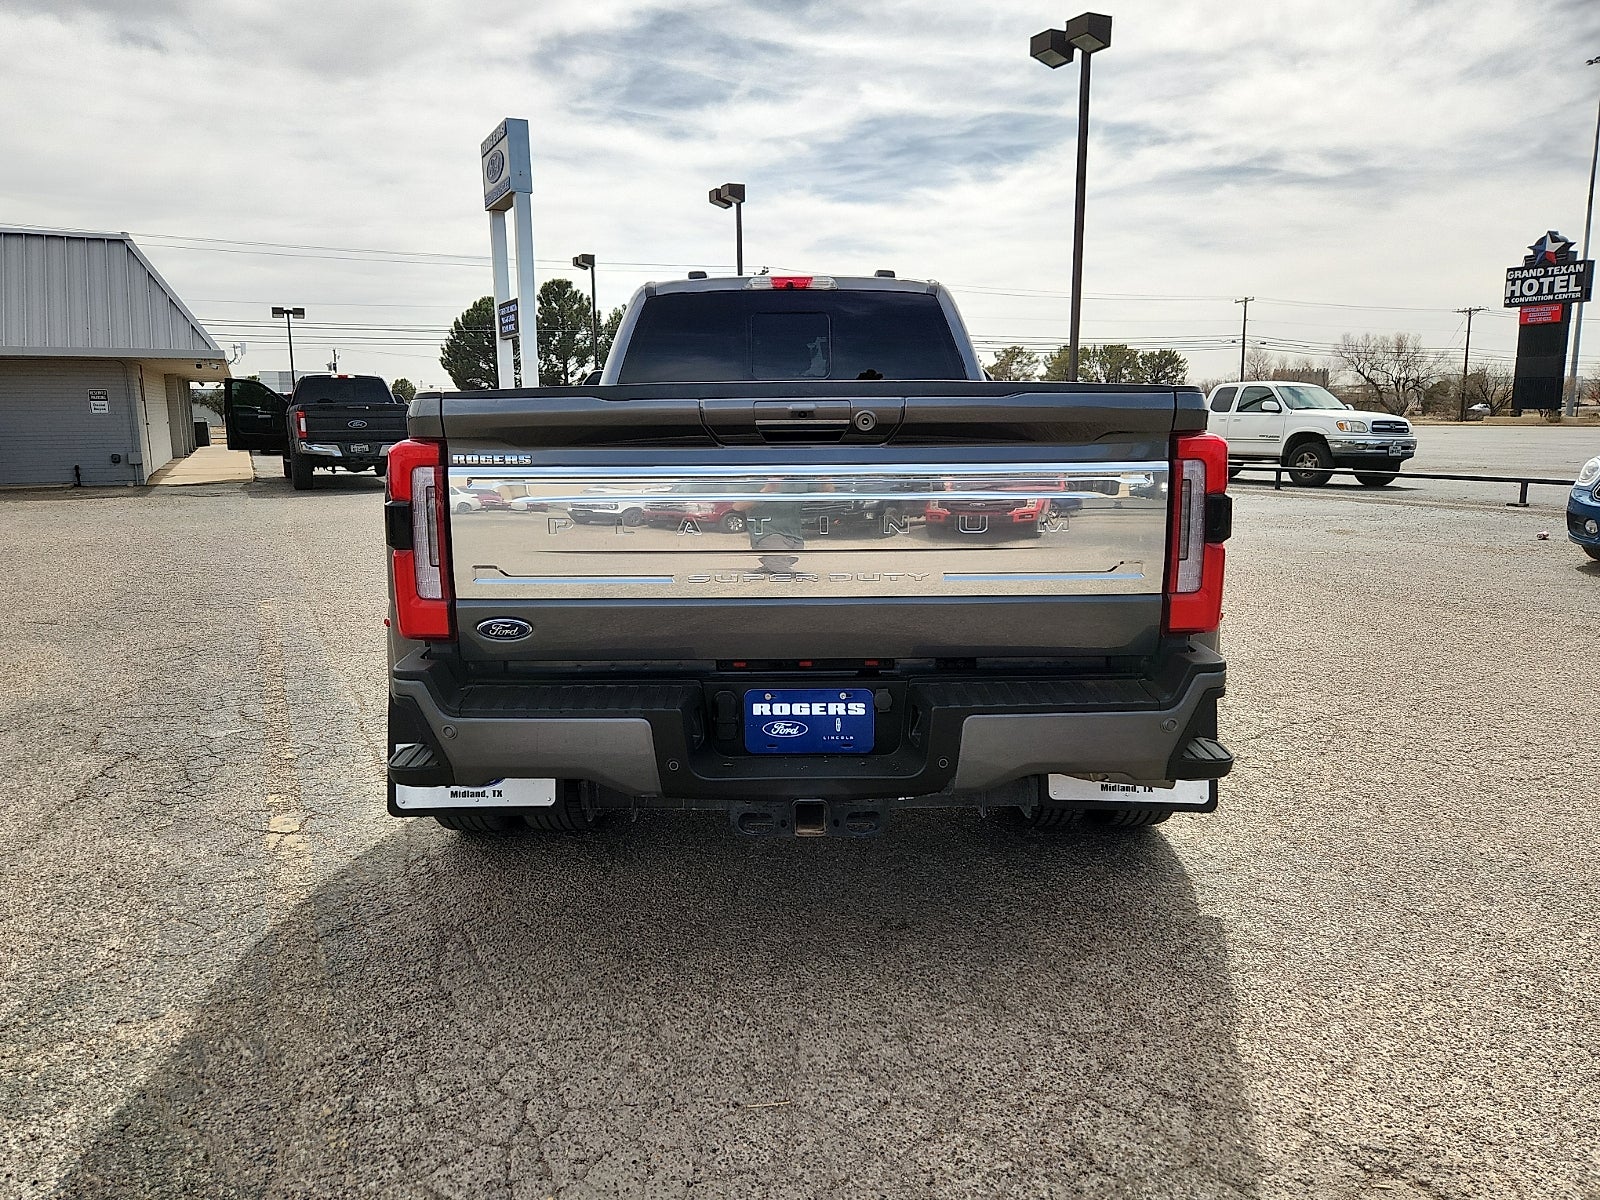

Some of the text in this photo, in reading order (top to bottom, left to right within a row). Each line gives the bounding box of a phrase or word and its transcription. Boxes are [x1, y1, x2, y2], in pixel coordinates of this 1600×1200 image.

[1507, 264, 1584, 279] GRAND TEXAN
[1505, 275, 1582, 298] HOTEL
[1511, 294, 1553, 304] CONVENTION
[1554, 292, 1581, 300] CENTER
[452, 454, 532, 465] ROGERS
[547, 515, 1070, 536] PLATINUM
[687, 572, 930, 584] SUPER DUTY
[489, 623, 519, 636] Ford
[752, 702, 866, 716] ROGERS
[770, 722, 800, 735] Ford
[450, 789, 503, 799] Midland, TX
[1100, 783, 1140, 794] Midland,
